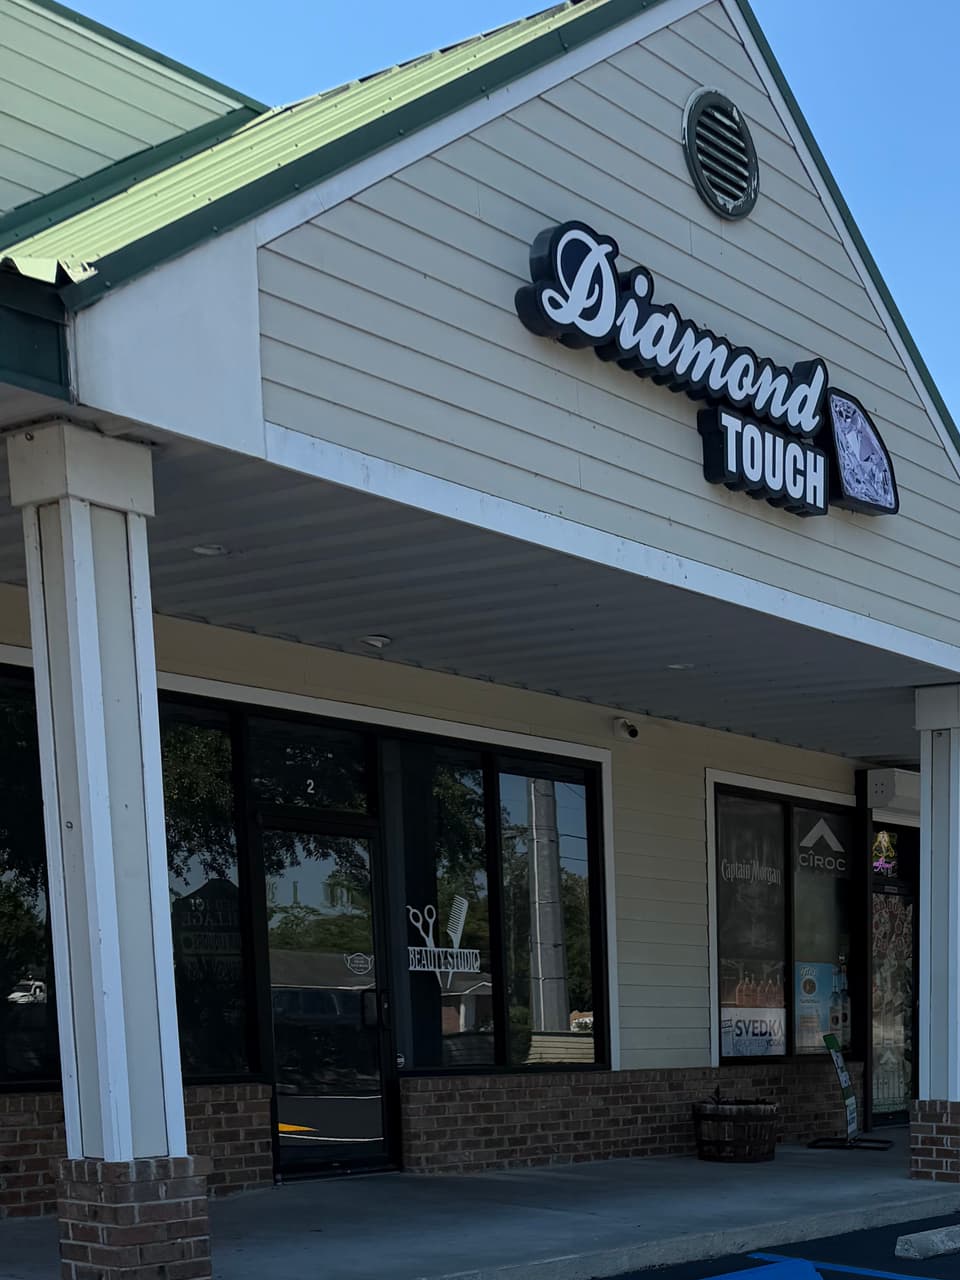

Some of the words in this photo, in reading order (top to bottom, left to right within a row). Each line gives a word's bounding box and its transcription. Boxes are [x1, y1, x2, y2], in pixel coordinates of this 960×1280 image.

[541, 229, 821, 432] Diamond
[721, 411, 825, 509] TOUCH
[306, 779, 316, 794] 2
[799, 849, 847, 871] CÎROC
[721, 858, 751, 882] Captain
[750, 858, 782, 888] Morgan
[408, 948, 446, 970] BEAUTY
[447, 949, 481, 971] STUDIO
[735, 1019, 785, 1038] SVEDKA
